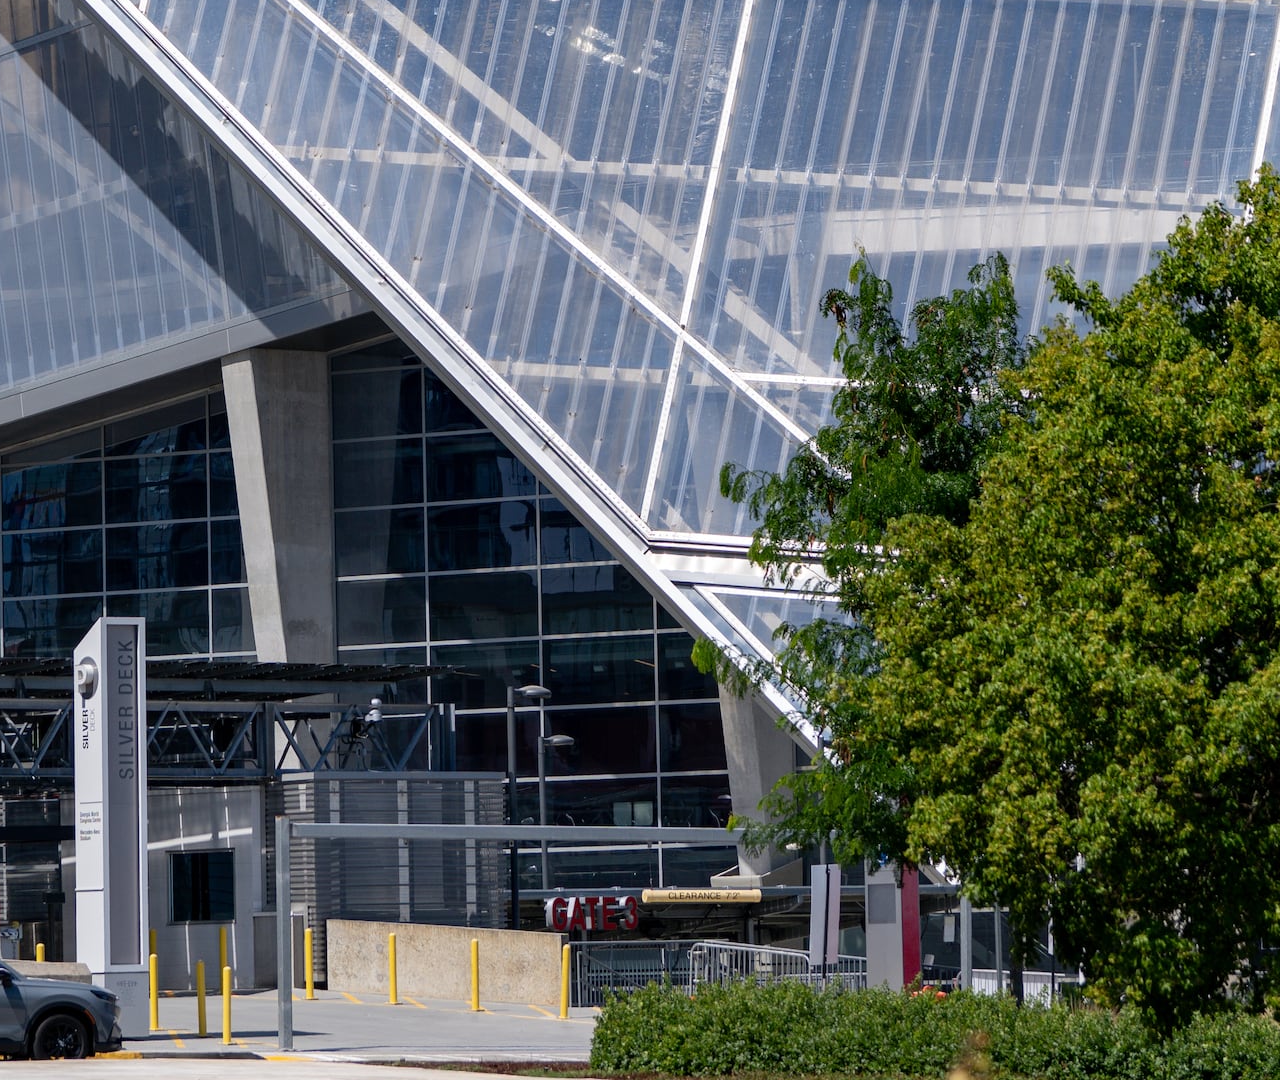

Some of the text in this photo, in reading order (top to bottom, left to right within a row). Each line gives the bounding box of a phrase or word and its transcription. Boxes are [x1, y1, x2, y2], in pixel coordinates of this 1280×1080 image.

[118, 640, 134, 779] SILVER DECK
[550, 896, 639, 931] GATE 3
[668, 891, 721, 901] CLEARANCE
